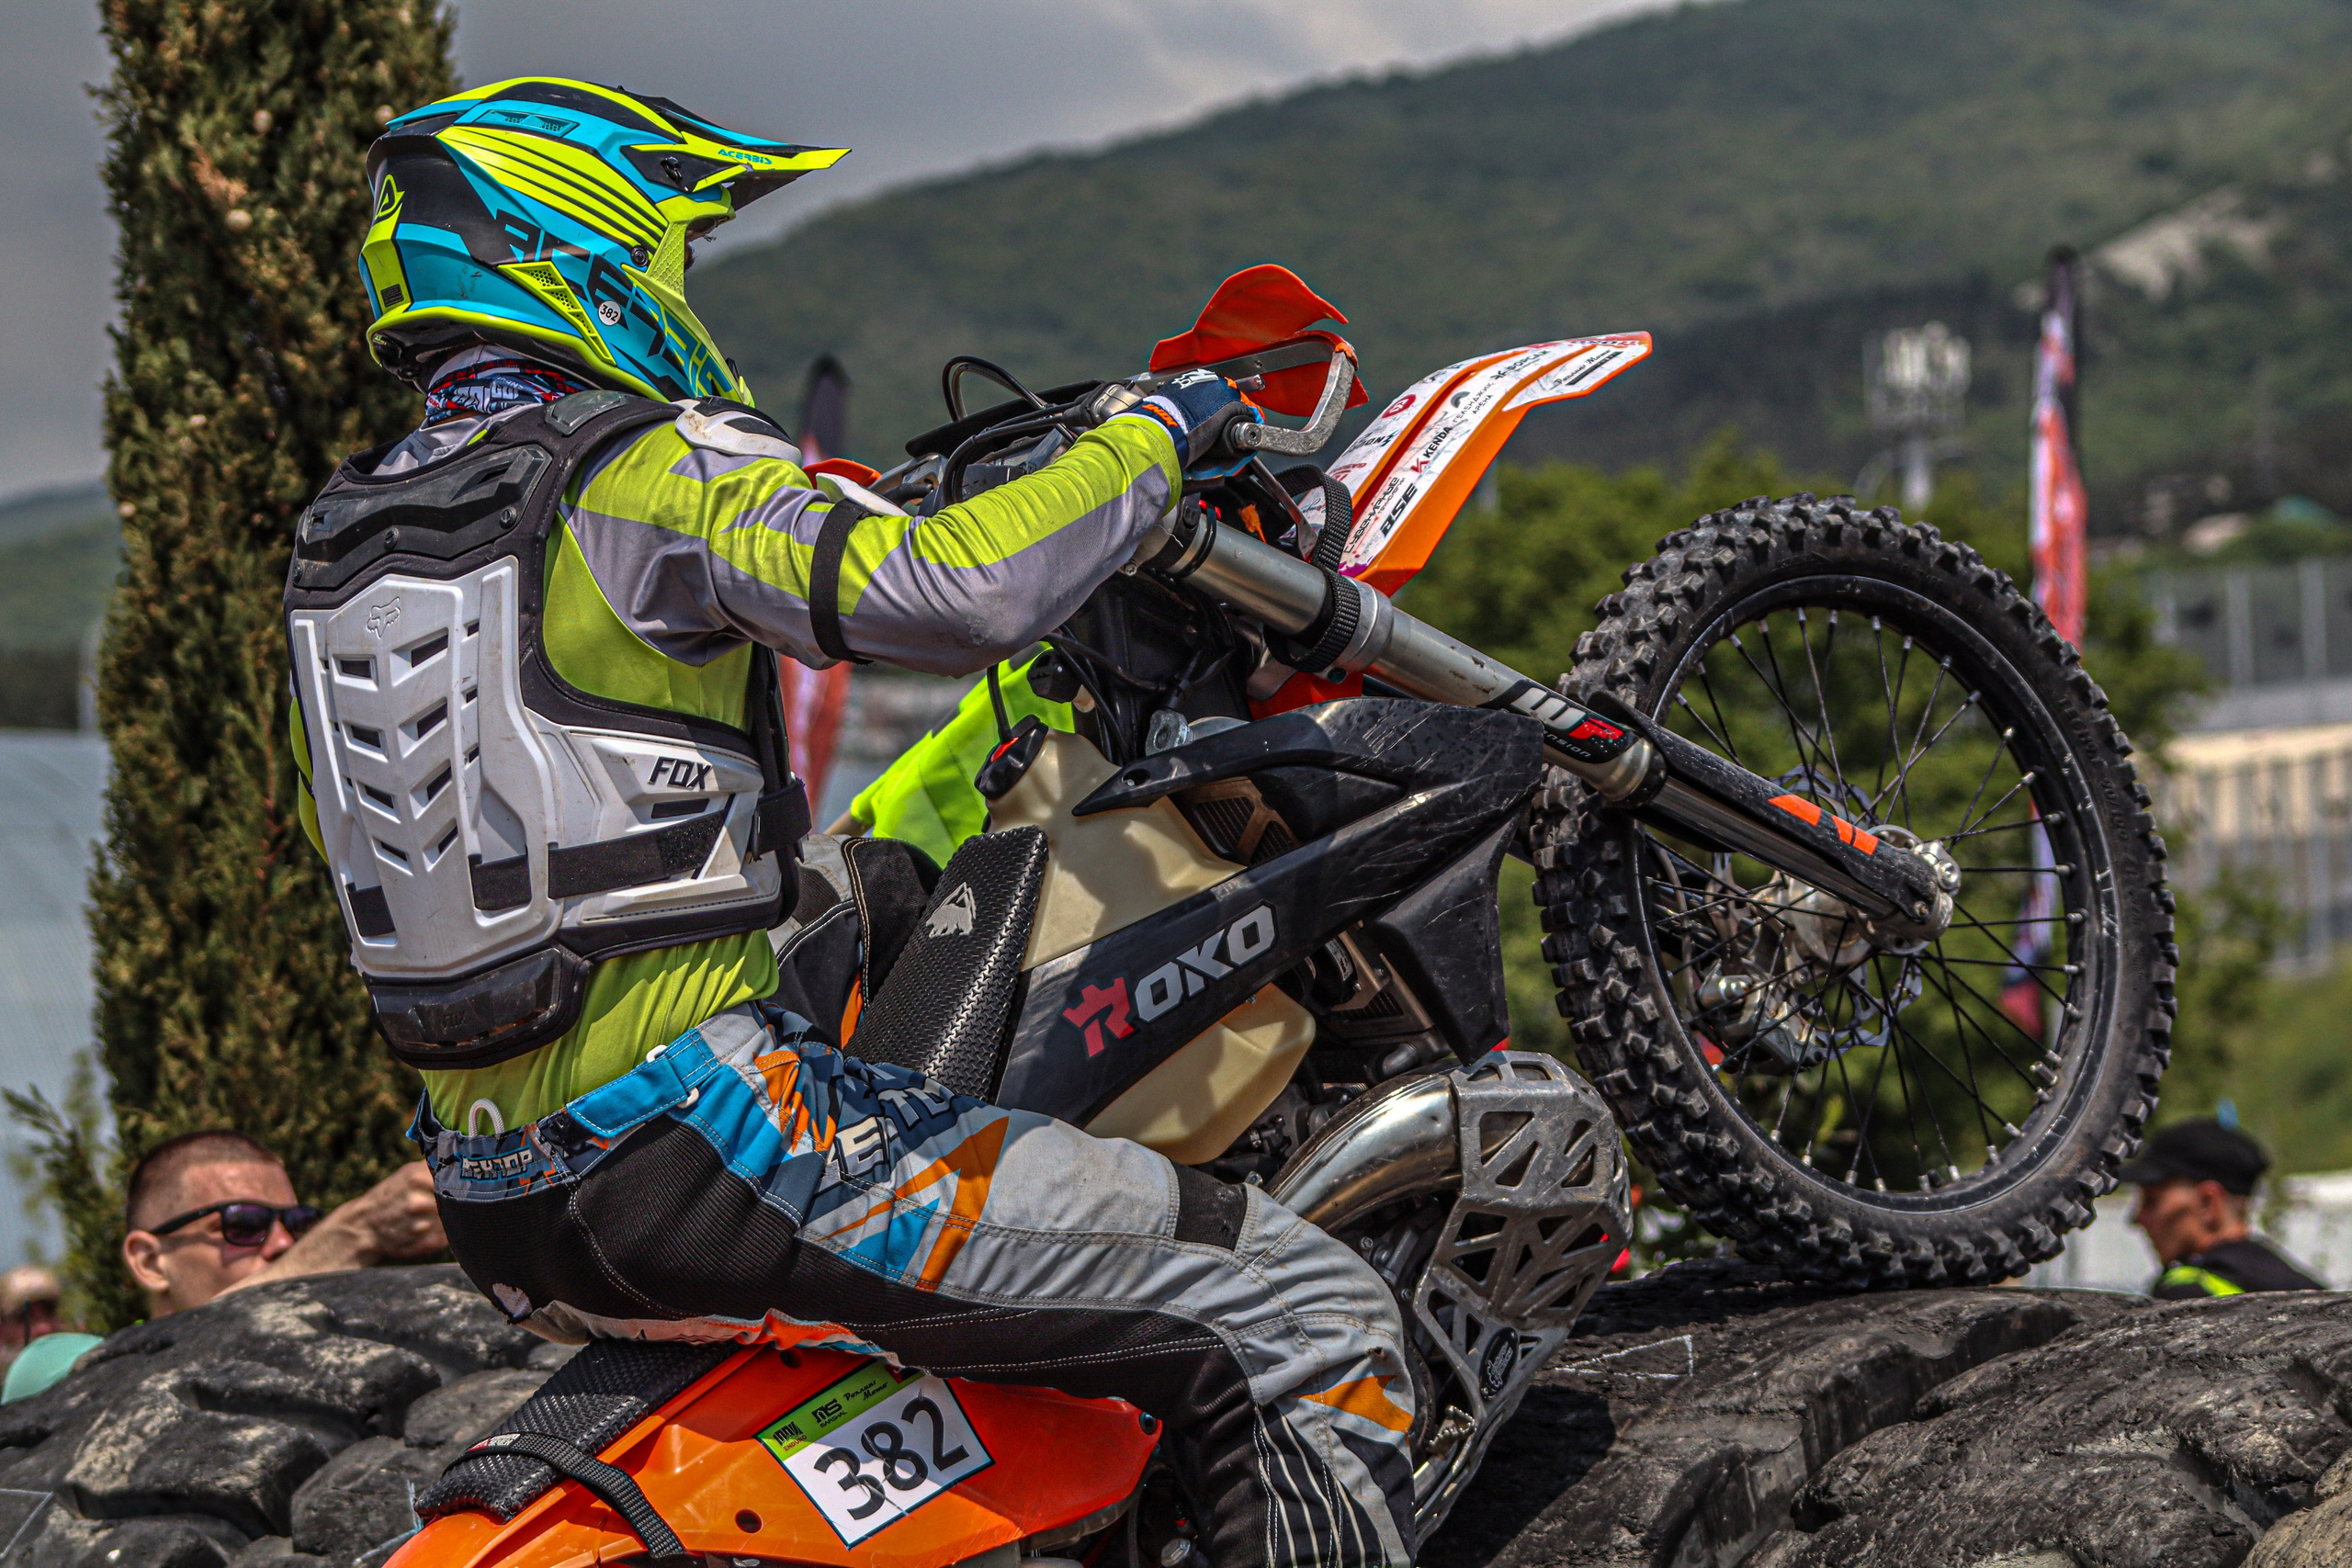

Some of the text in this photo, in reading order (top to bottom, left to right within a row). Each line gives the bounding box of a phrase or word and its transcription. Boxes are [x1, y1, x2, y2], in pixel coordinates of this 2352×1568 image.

[718, 149, 772, 164] ACERBIS
[599, 304, 618, 322] 382
[1473, 394, 1493, 414] АРЕНА
[1423, 426, 1453, 458] KENDA
[648, 756, 711, 790] FOX
[1062, 905, 1275, 1057] ROKO
[820, 1410, 847, 1428] MARSHAL
[783, 1435, 808, 1451] ENDURO
[813, 1395, 970, 1521] 382
